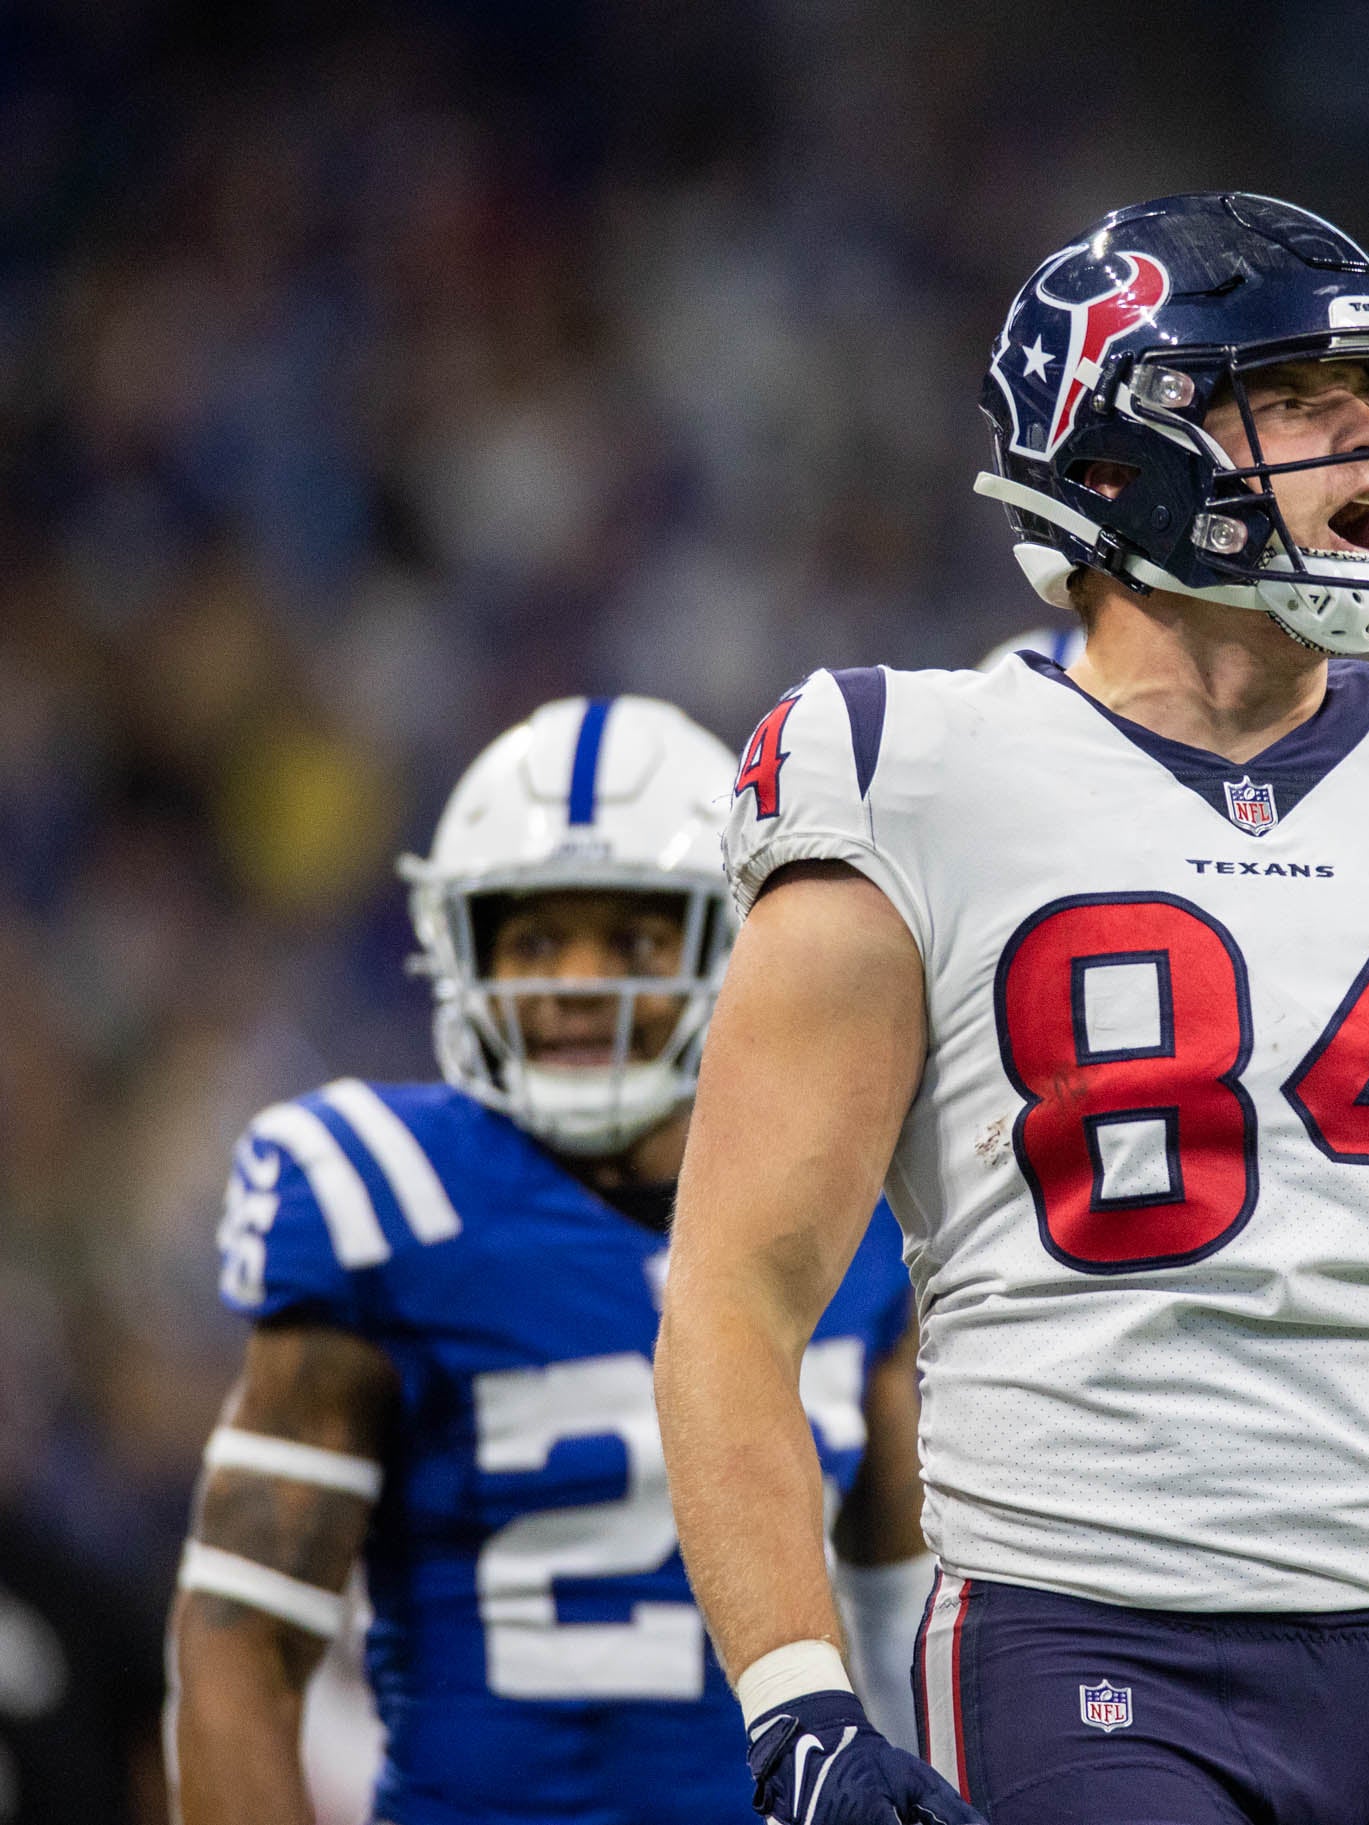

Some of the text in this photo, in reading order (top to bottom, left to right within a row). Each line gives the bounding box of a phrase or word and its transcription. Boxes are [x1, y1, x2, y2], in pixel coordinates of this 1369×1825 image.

[1236, 802, 1270, 823] NFL
[1185, 858, 1335, 878] TEXANS
[1090, 1703, 1124, 1722] NFL
